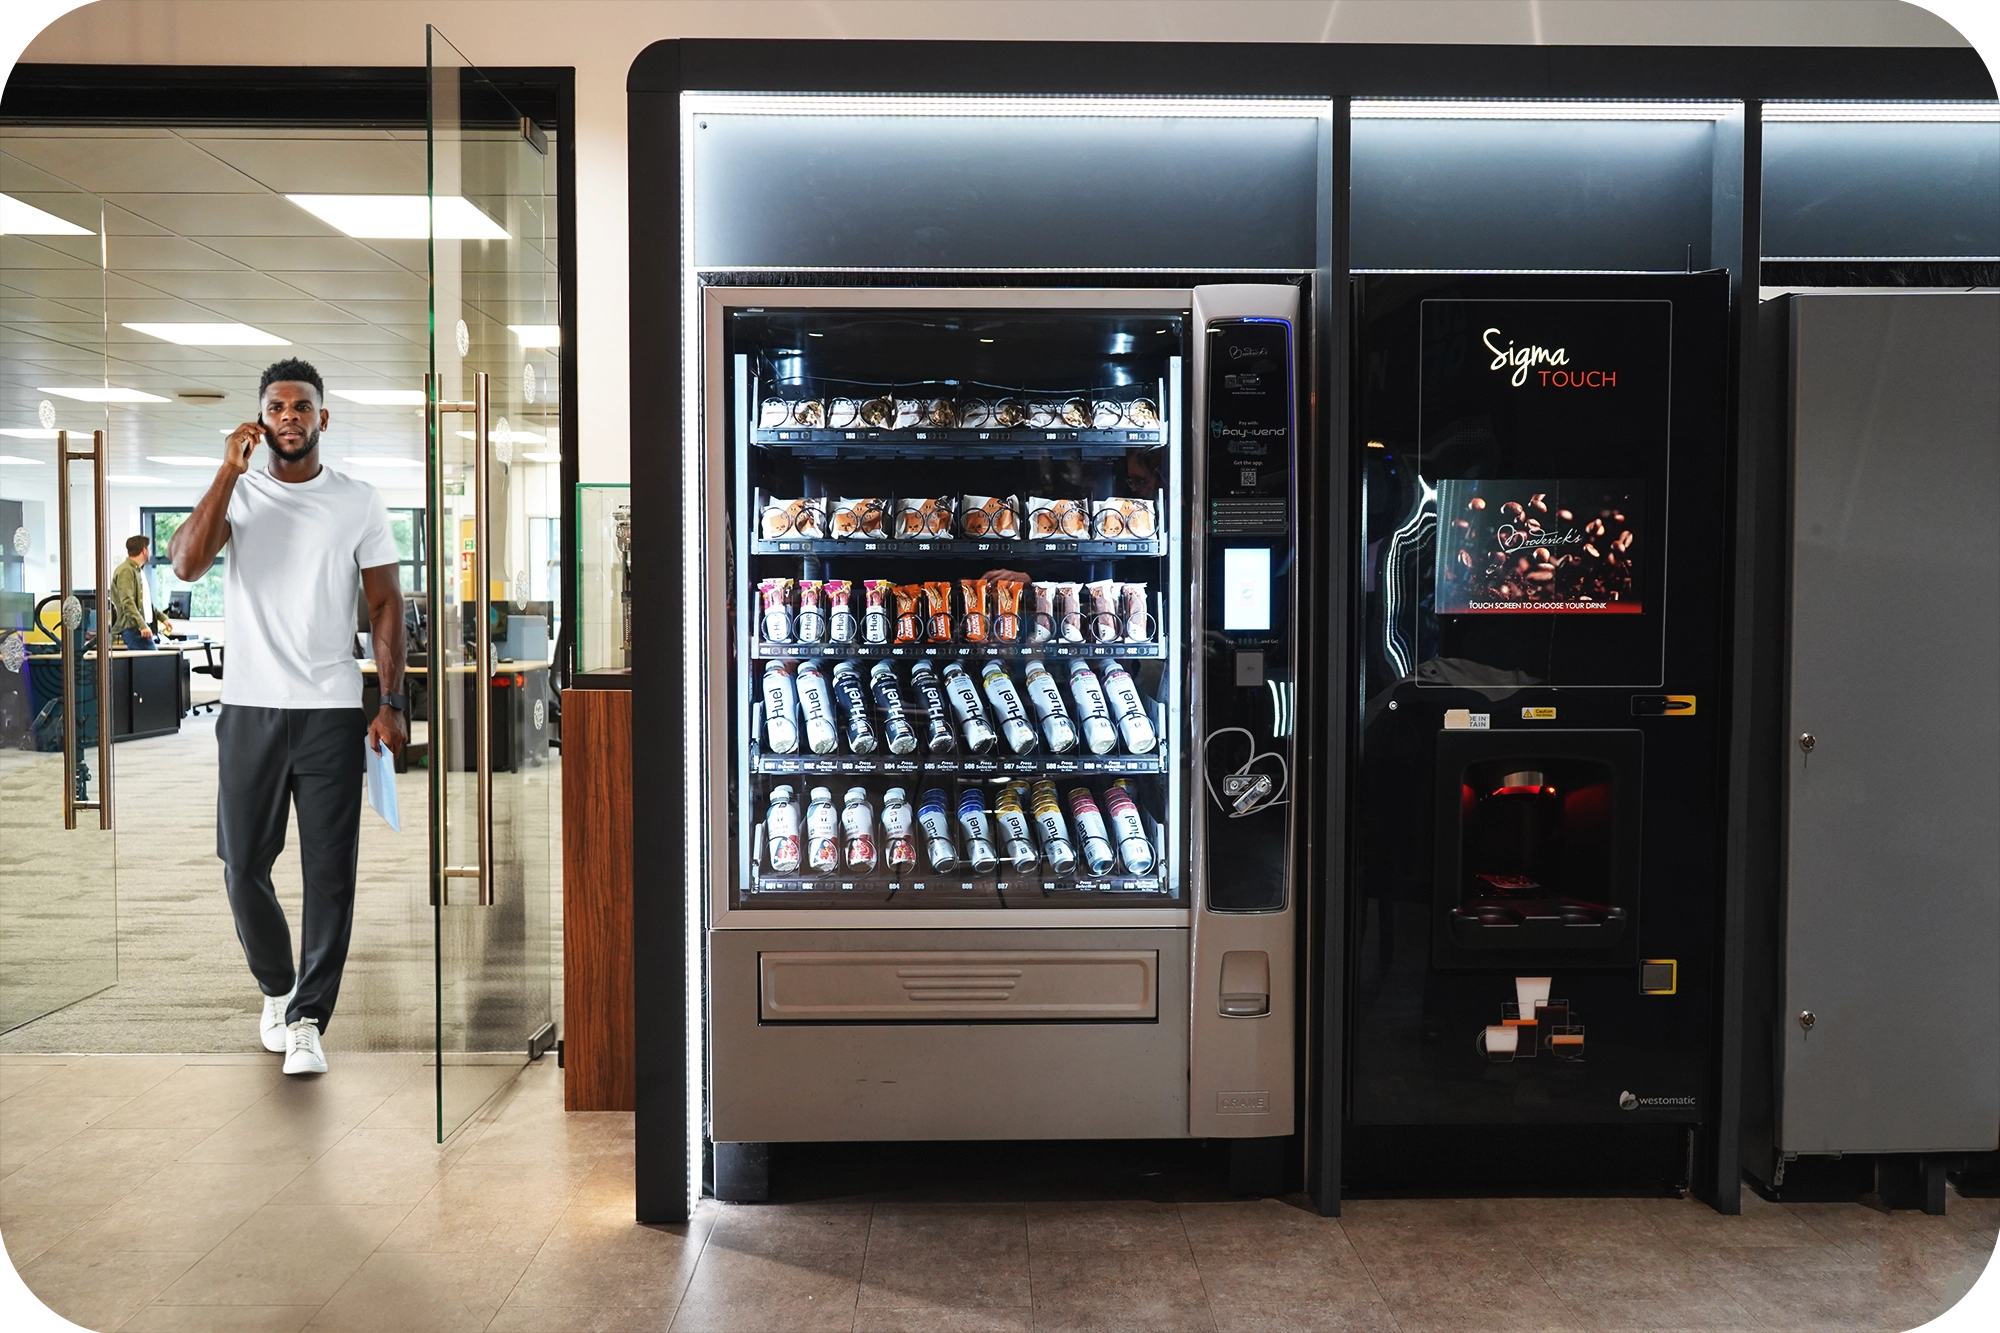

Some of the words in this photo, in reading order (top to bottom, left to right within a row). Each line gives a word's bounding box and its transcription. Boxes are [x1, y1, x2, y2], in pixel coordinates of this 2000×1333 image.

[1482, 328, 1570, 388] Sigma
[1538, 370, 1616, 387] TOUCH
[1469, 600, 1494, 609] TOUCH
[769, 688, 784, 719] Huel
[805, 688, 823, 720] Huel
[844, 686, 866, 722] Huel
[883, 688, 905, 718] Huel
[923, 687, 944, 719] Huel
[958, 689, 982, 718] Huel
[999, 690, 1022, 719] Huel
[1043, 689, 1066, 720] Huel
[1087, 690, 1106, 719] Huel
[1119, 690, 1141, 720] Huel
[1222, 1098, 1264, 1108] CRANE
[1640, 1096, 1696, 1105] westomatic
